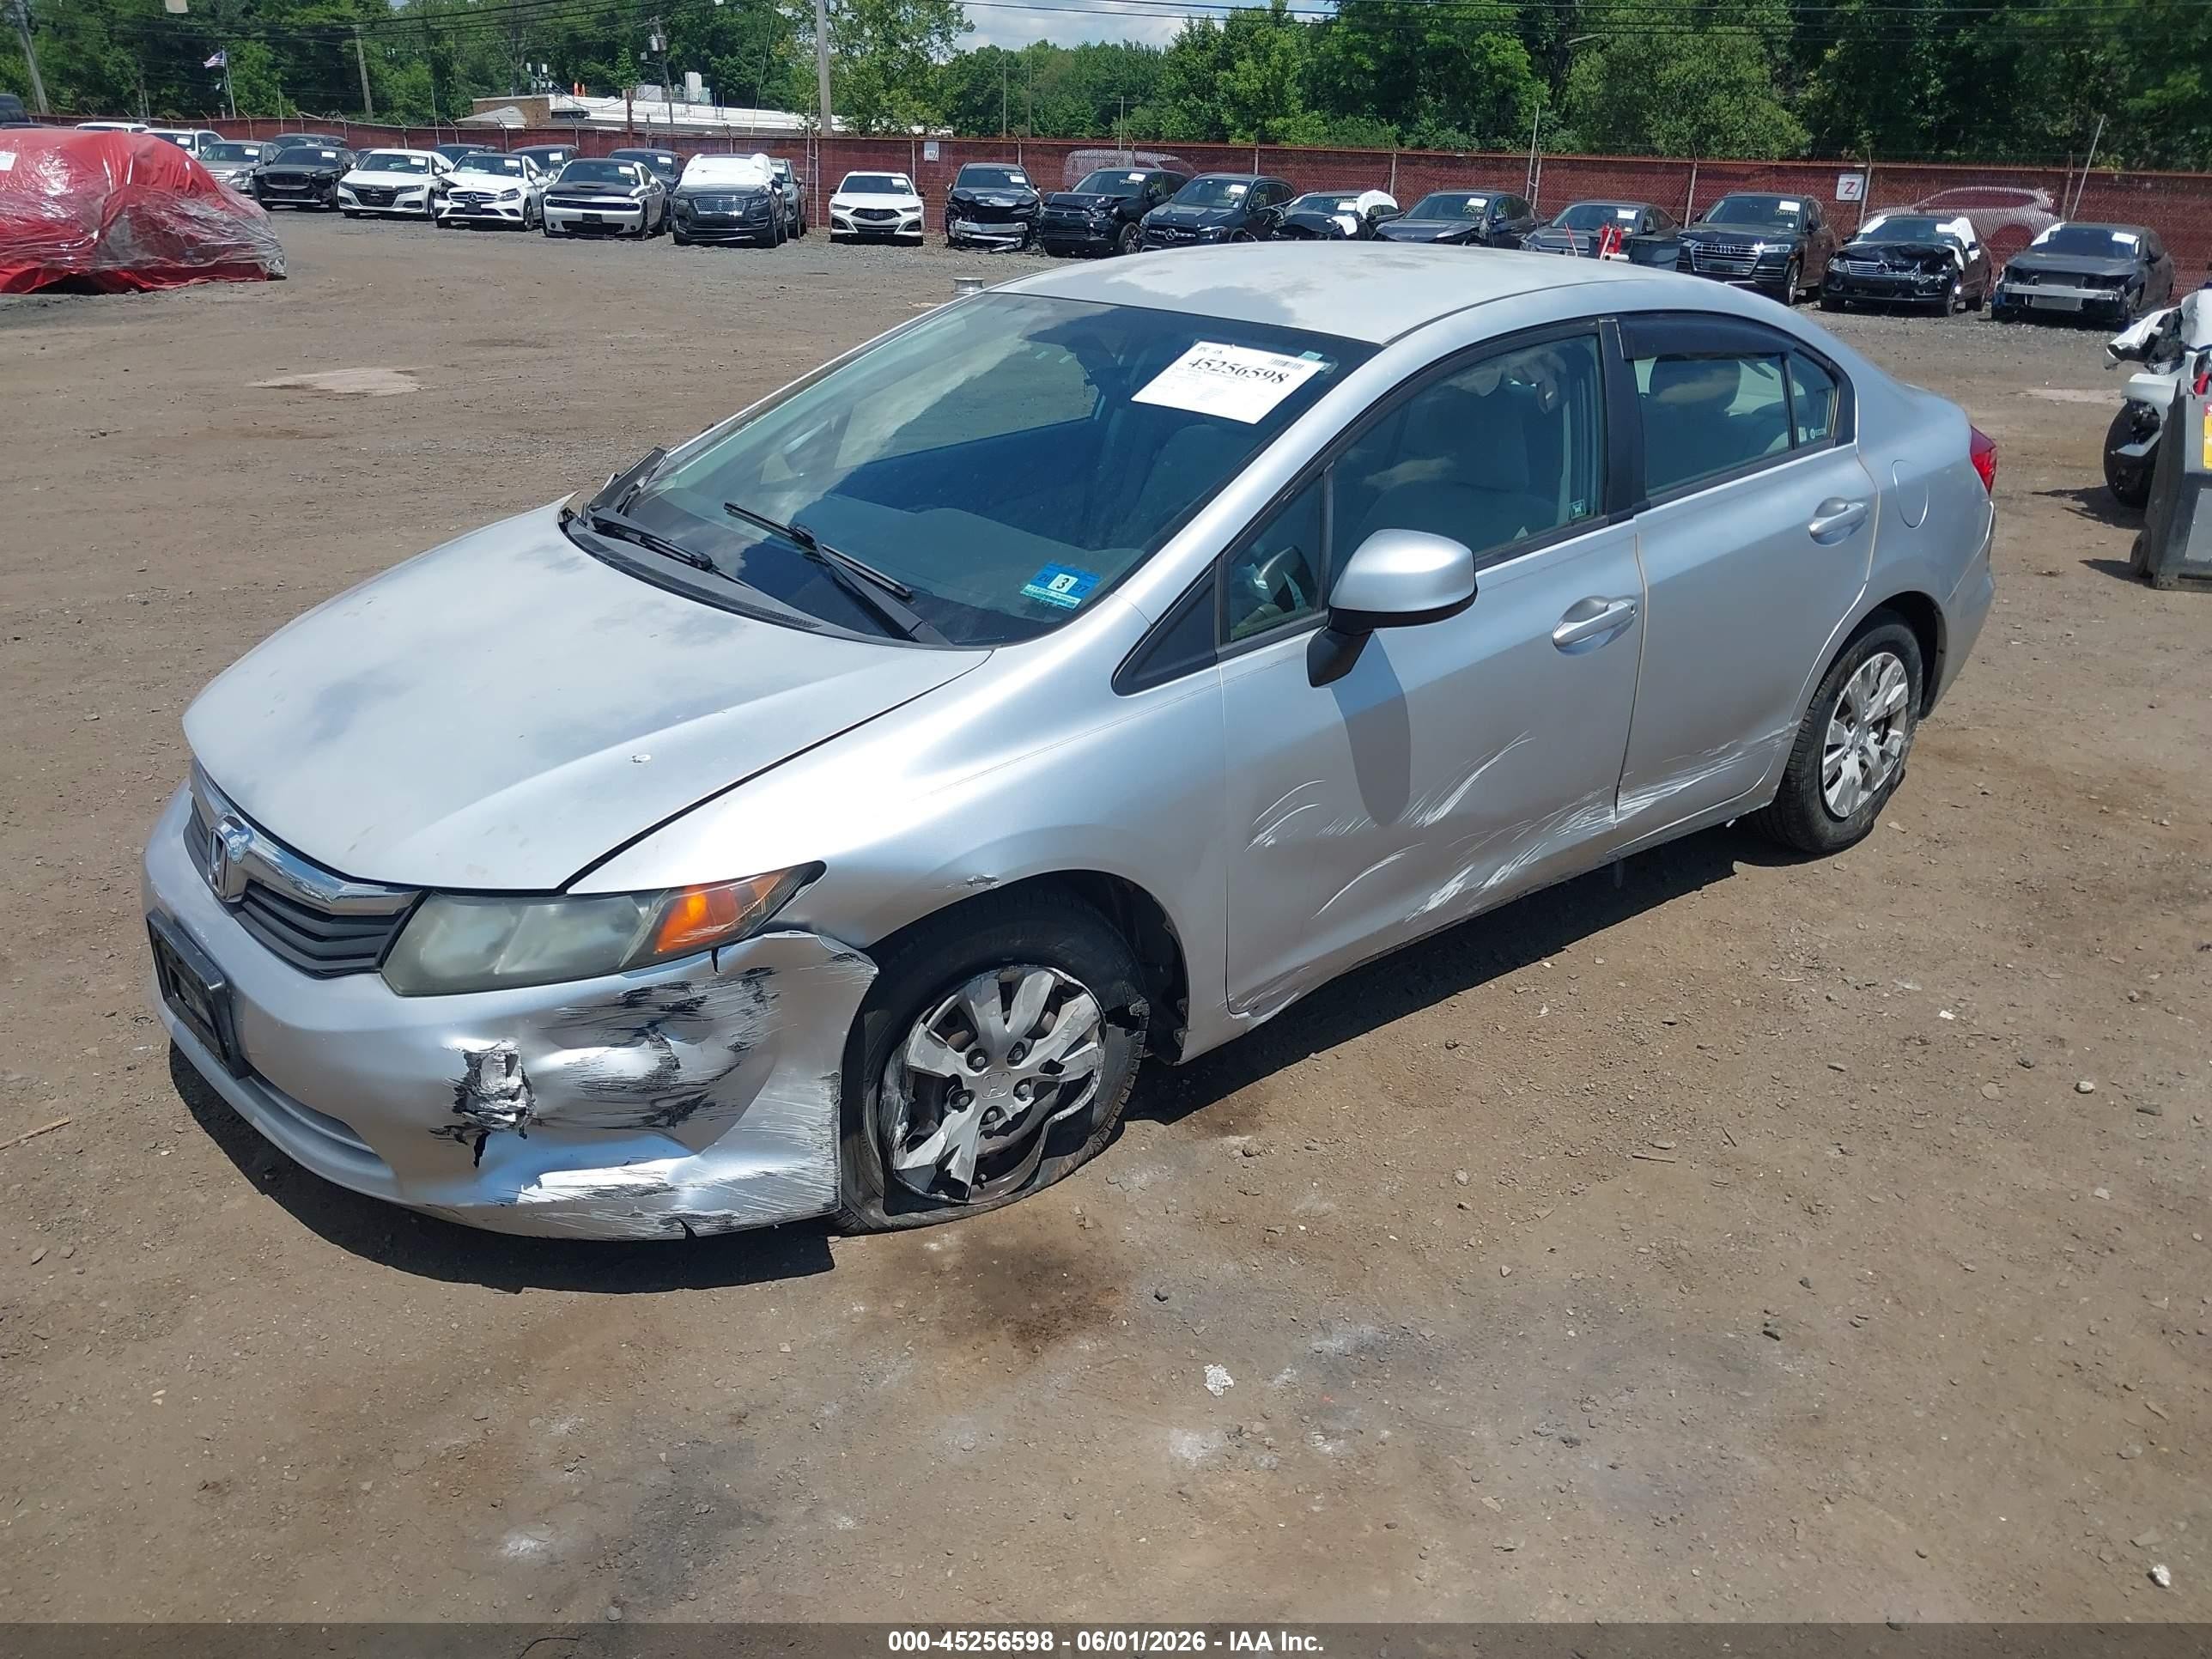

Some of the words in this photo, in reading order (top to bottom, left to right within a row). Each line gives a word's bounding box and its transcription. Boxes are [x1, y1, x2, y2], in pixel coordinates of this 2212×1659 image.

[1844, 181, 1856, 195] Z
[1188, 357, 1290, 384] 45256598
[1056, 577, 1070, 590] 3
